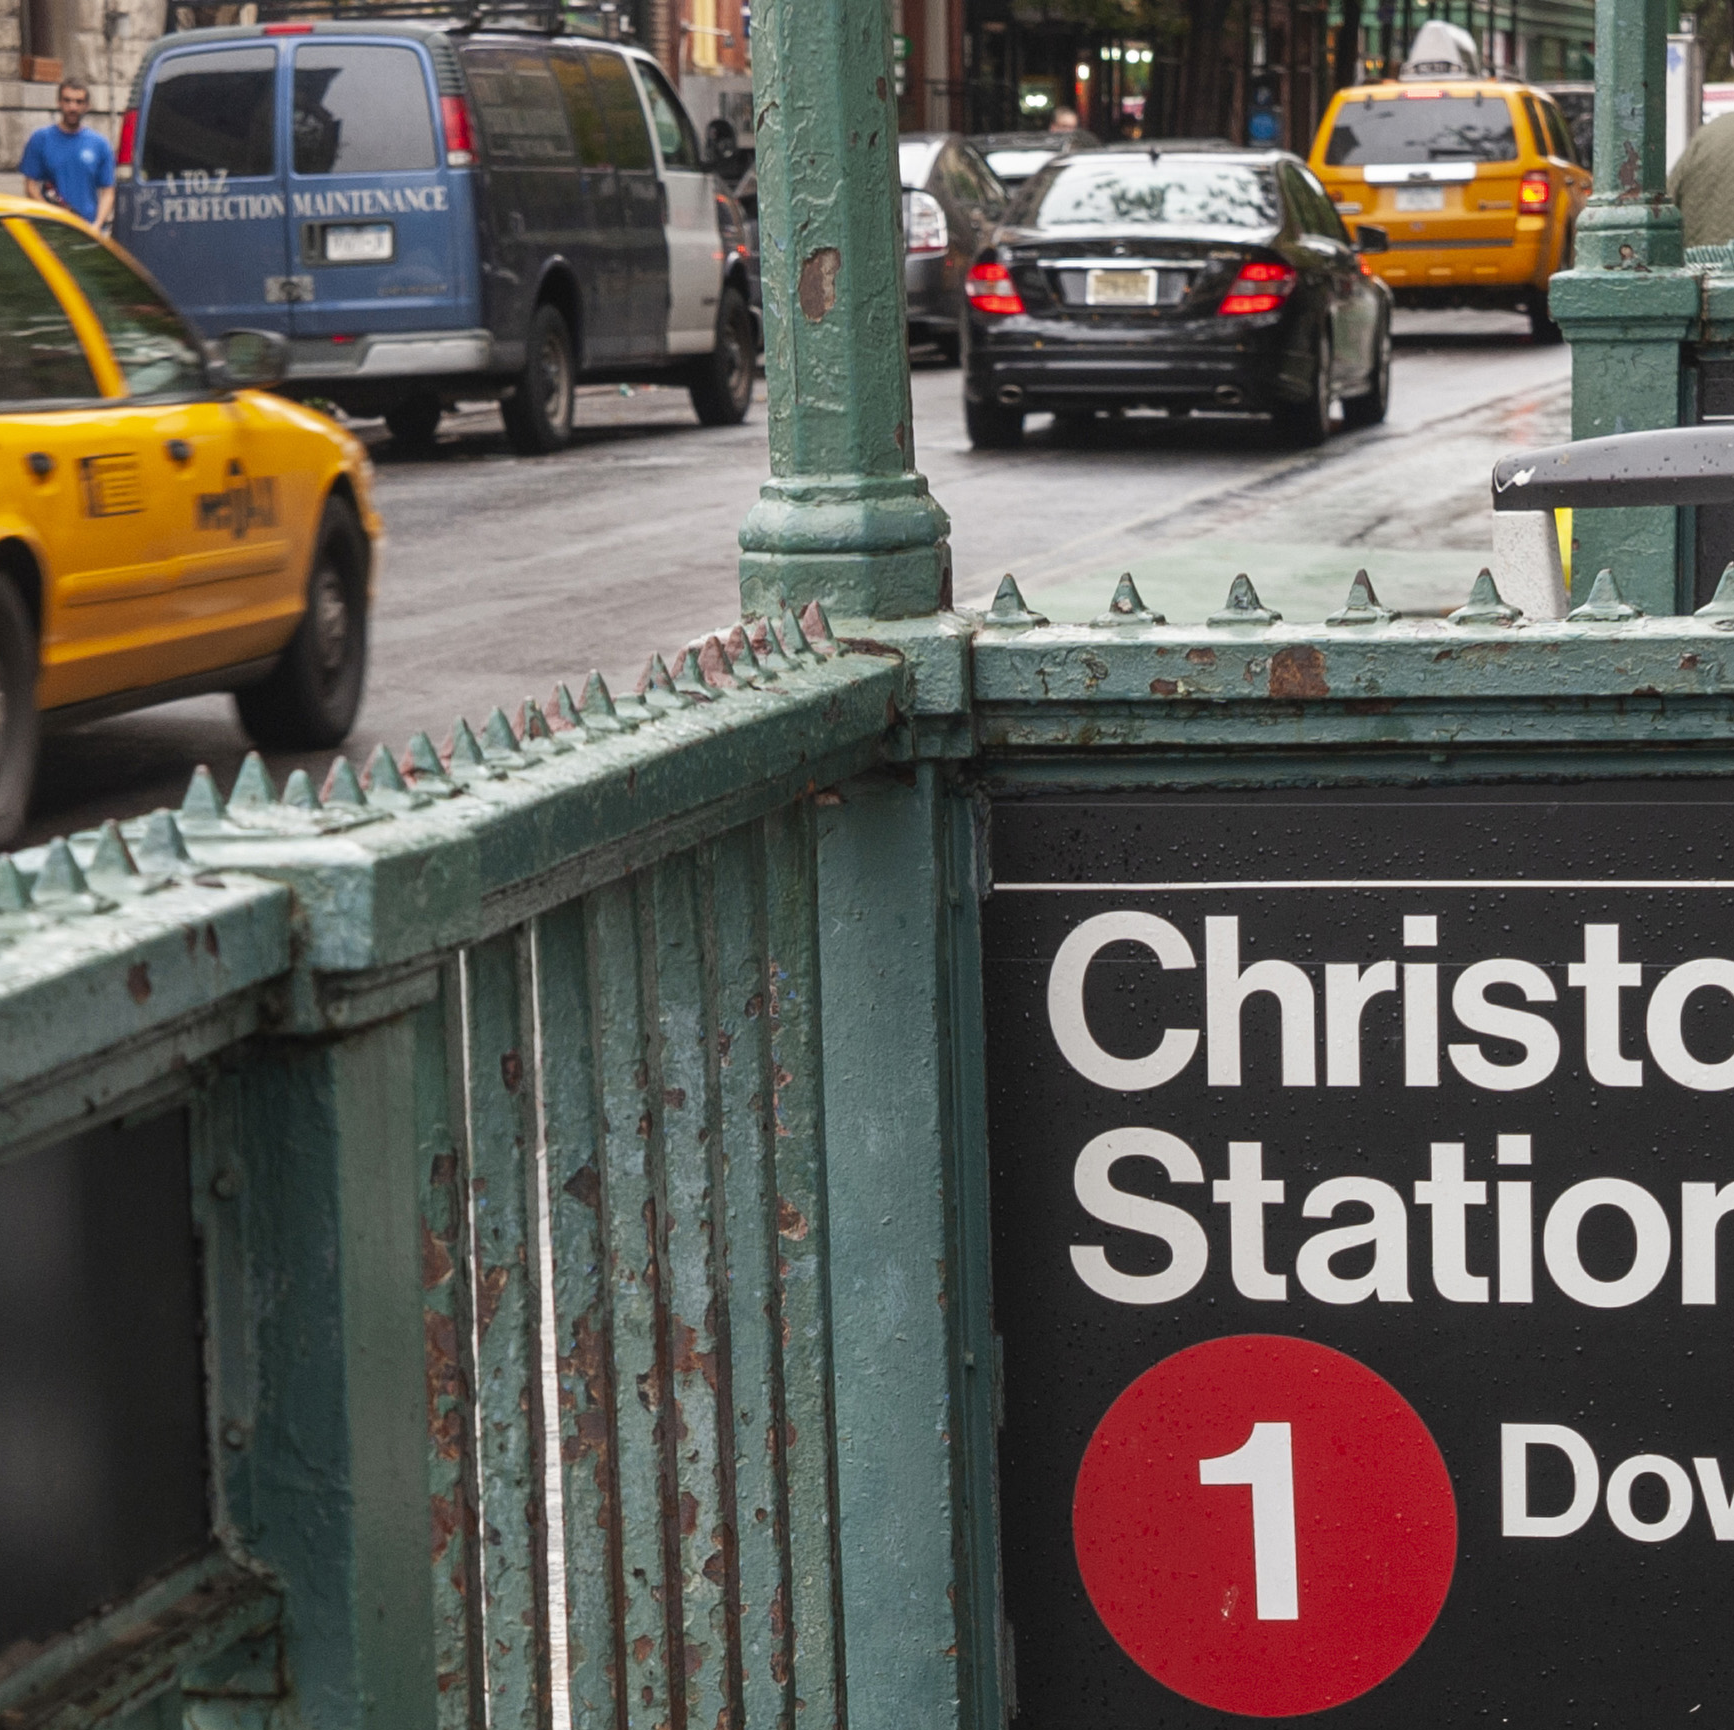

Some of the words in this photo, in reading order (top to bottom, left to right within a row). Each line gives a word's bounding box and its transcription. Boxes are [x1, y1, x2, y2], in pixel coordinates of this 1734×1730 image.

[163, 194, 286, 222] PERFECTION
[291, 186, 450, 218] MAINTENANCE
[1199, 1422, 1298, 1620] 1
